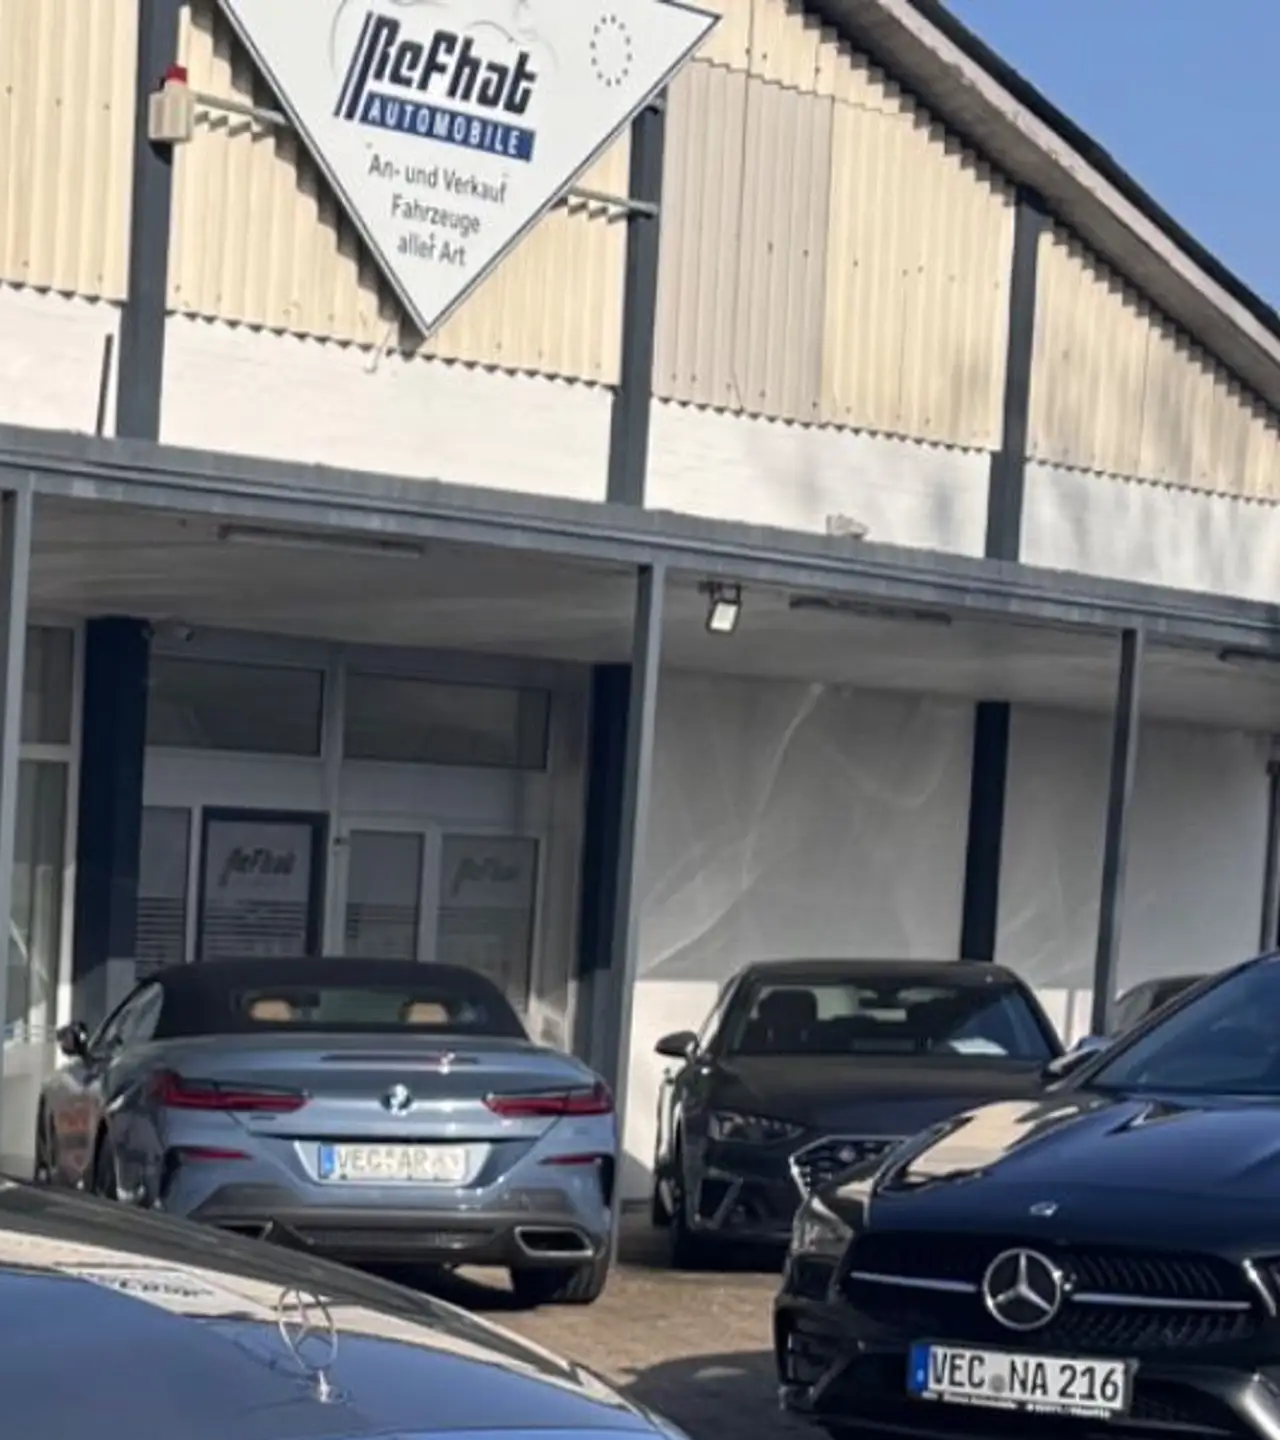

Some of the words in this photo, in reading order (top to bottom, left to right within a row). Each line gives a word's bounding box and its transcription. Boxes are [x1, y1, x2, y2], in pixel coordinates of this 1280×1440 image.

[367, 97, 520, 155] AUTOMOBILE
[368, 153, 401, 181] An-
[404, 165, 439, 189] und
[443, 168, 507, 204] Verkauf
[391, 192, 481, 239] Fahrzeuge
[438, 240, 467, 267] Art
[931, 1352, 986, 1389] VEC
[1009, 1357, 1048, 1397] NA
[1058, 1363, 1119, 1403] 216
